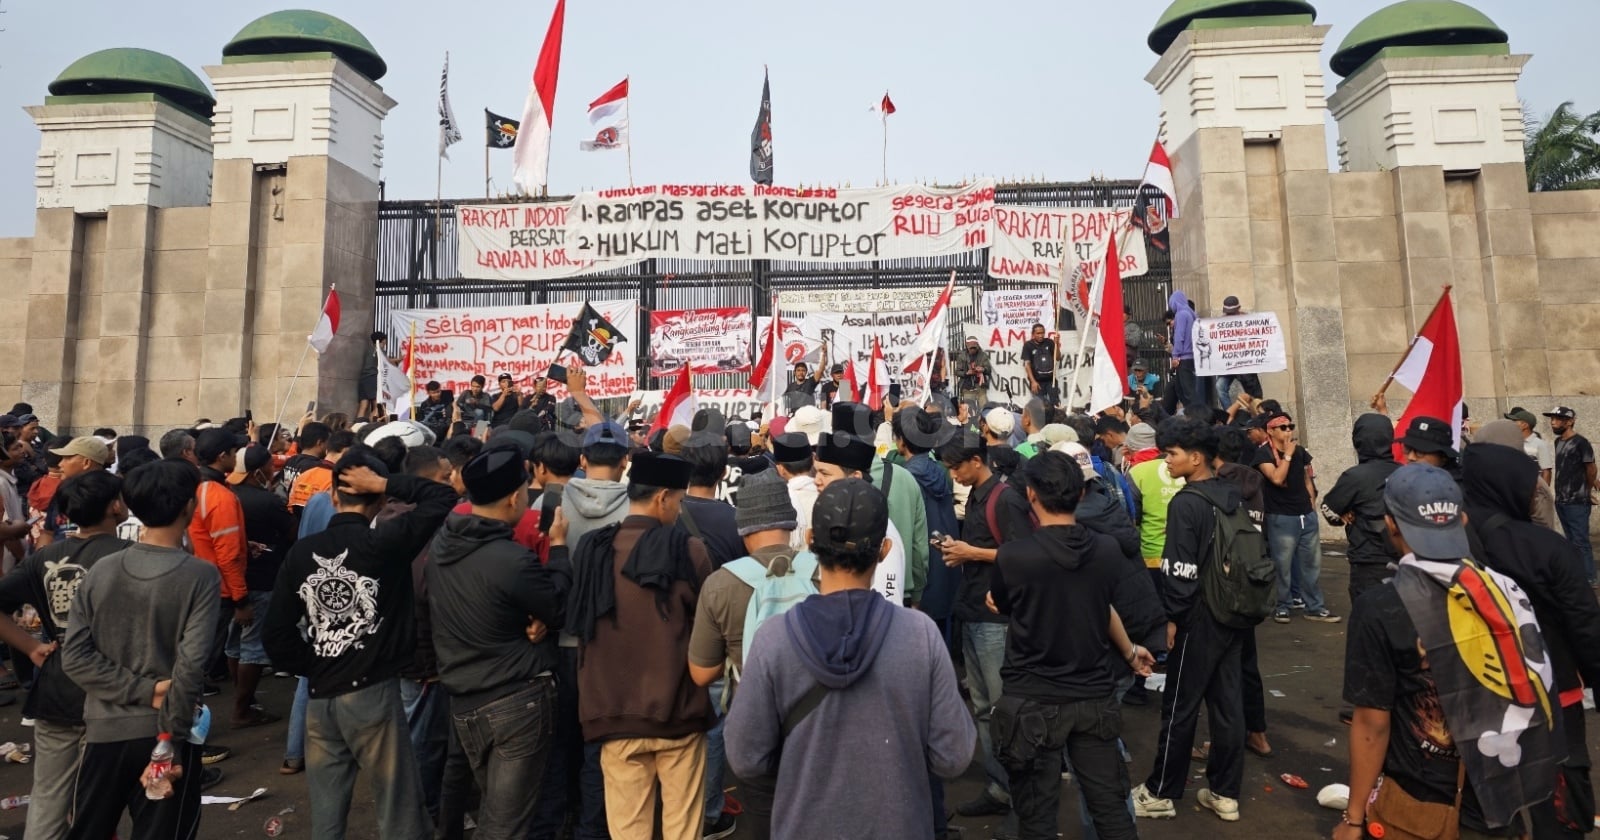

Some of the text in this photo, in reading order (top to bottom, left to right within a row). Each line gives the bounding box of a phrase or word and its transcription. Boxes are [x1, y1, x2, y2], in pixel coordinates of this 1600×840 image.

[696, 199, 758, 222] aset
[892, 194, 954, 211] segera
[460, 207, 520, 230] RAKYAT
[894, 213, 941, 237] RUU
[509, 228, 566, 248] BERSAT
[597, 229, 680, 257] HUKUM
[695, 228, 753, 256] Mati
[477, 248, 537, 270] LAWAN
[990, 255, 1050, 278] LAWAN
[1417, 501, 1459, 516] CANADA
